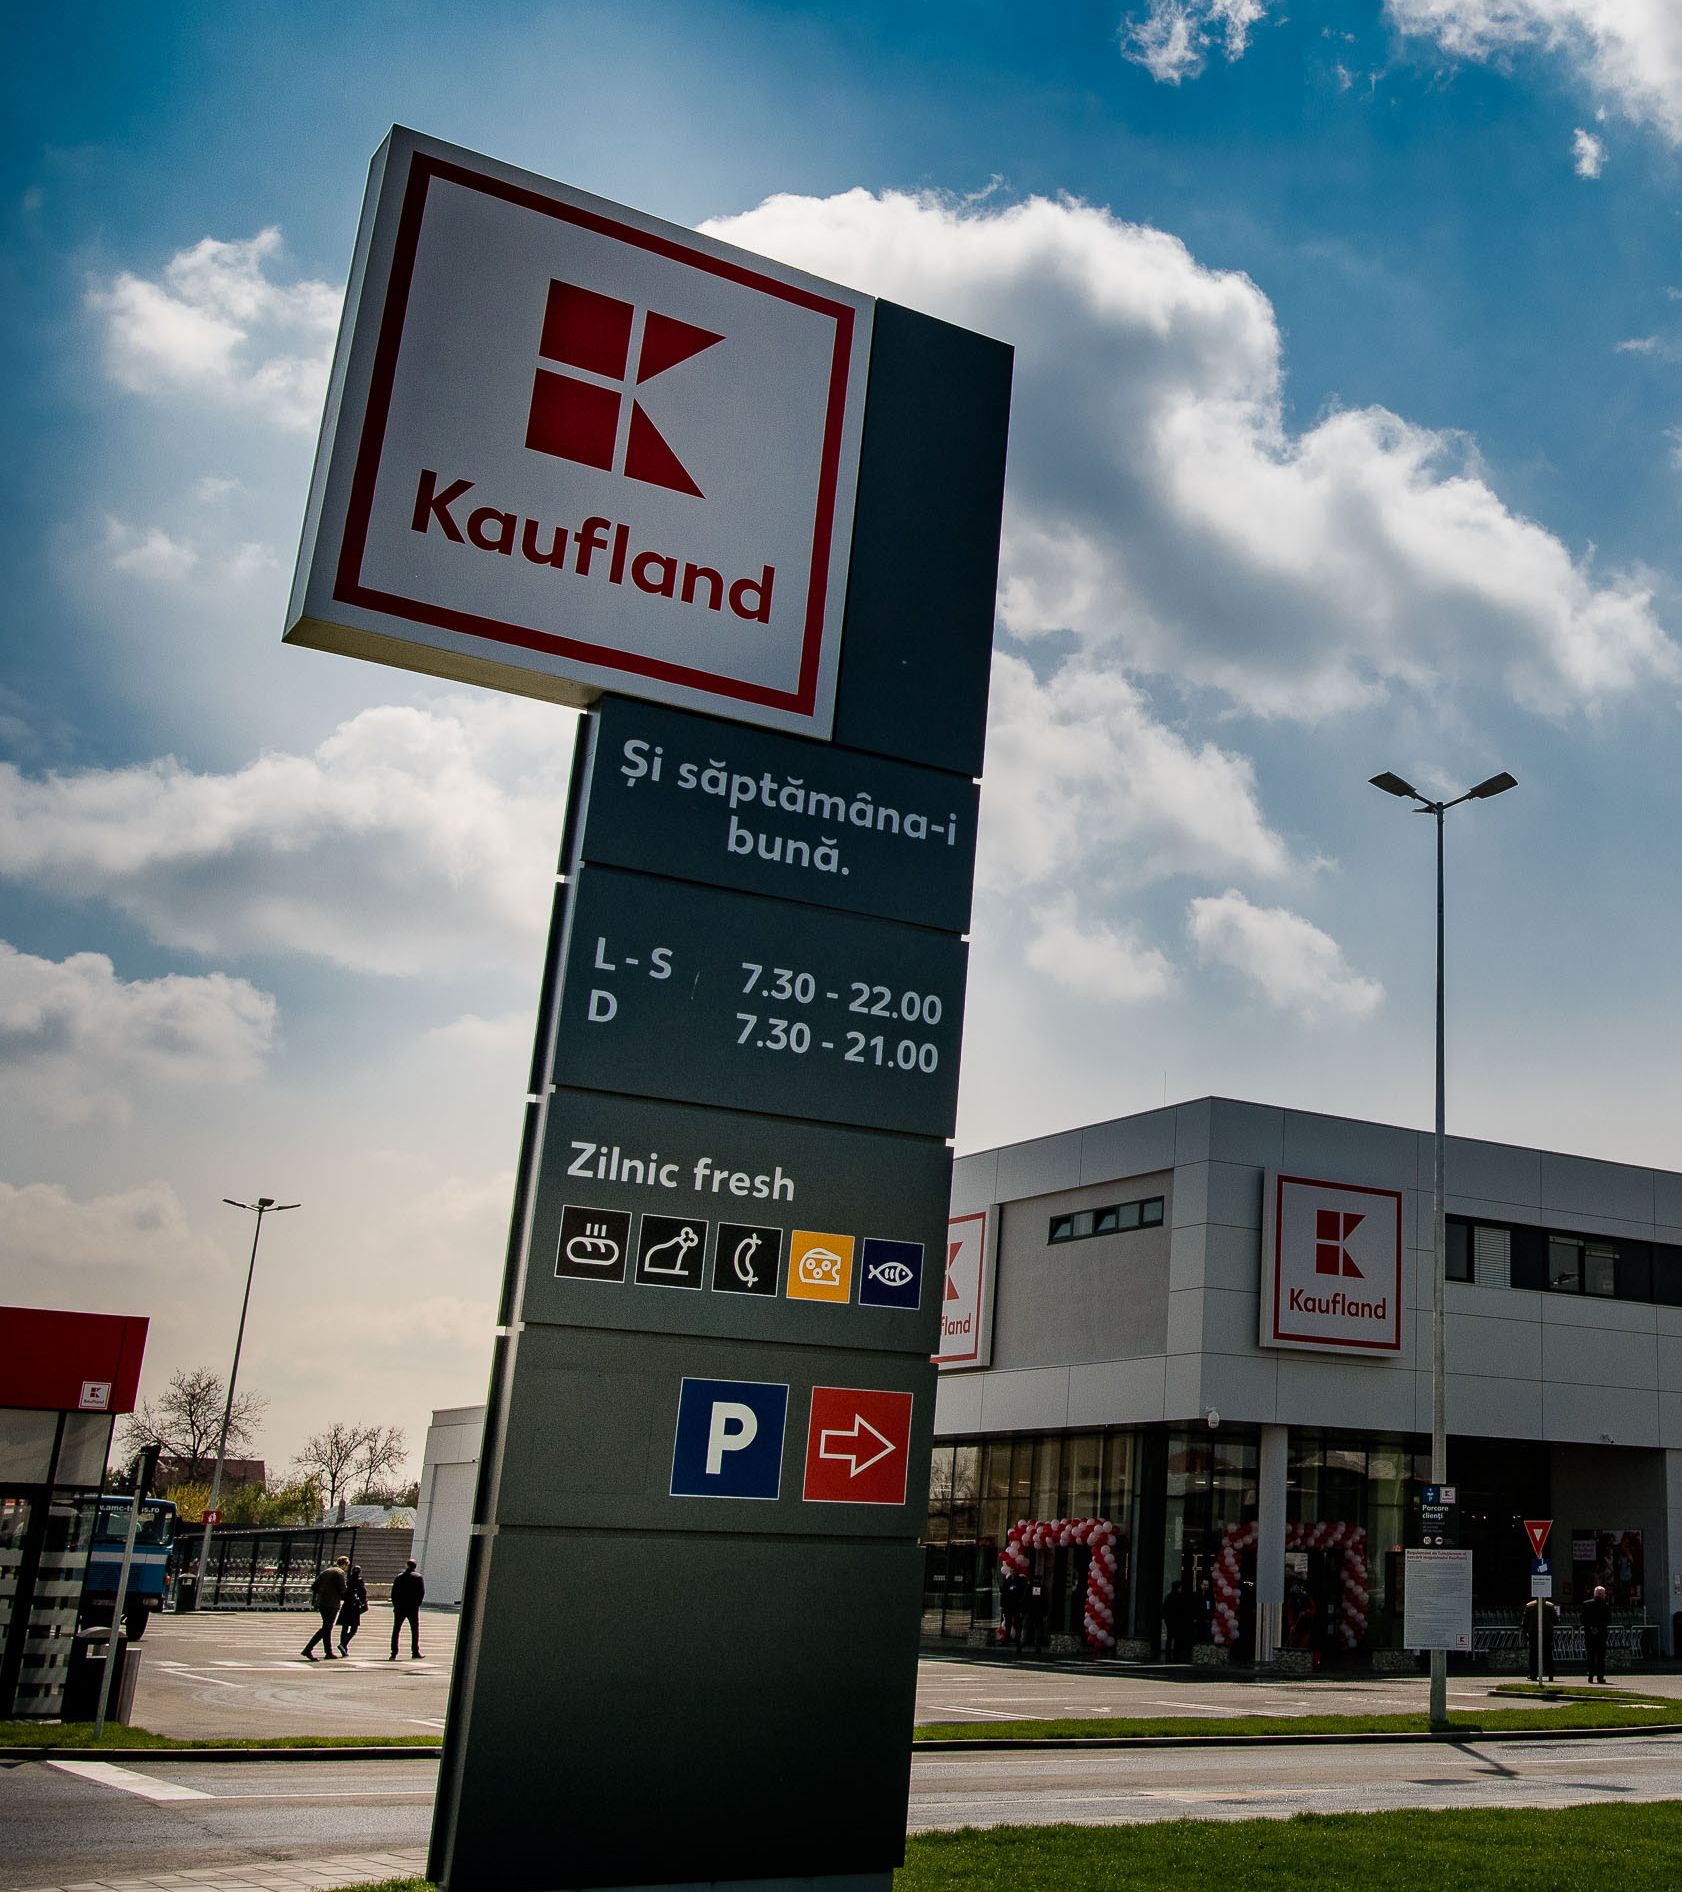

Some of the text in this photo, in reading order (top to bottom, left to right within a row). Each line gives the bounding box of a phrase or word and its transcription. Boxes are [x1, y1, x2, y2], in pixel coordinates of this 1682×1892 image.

[411, 469, 775, 624] Kaufland
[621, 740, 957, 846] Și săptămâna-i
[727, 817, 850, 876] bună.
[594, 937, 616, 971] L
[649, 947, 673, 979] S
[587, 989, 617, 1023] D
[741, 962, 816, 1004] 7.30
[849, 982, 942, 1025] 22.00
[736, 1013, 811, 1054] 7.30
[844, 1031, 940, 1074] 21.00
[567, 1141, 796, 1202] Zilnic fresh
[940, 1313, 972, 1336] fland
[1290, 1287, 1386, 1320] Kaufland
[706, 1402, 758, 1475] P
[1422, 1504, 1449, 1512] Parcare
